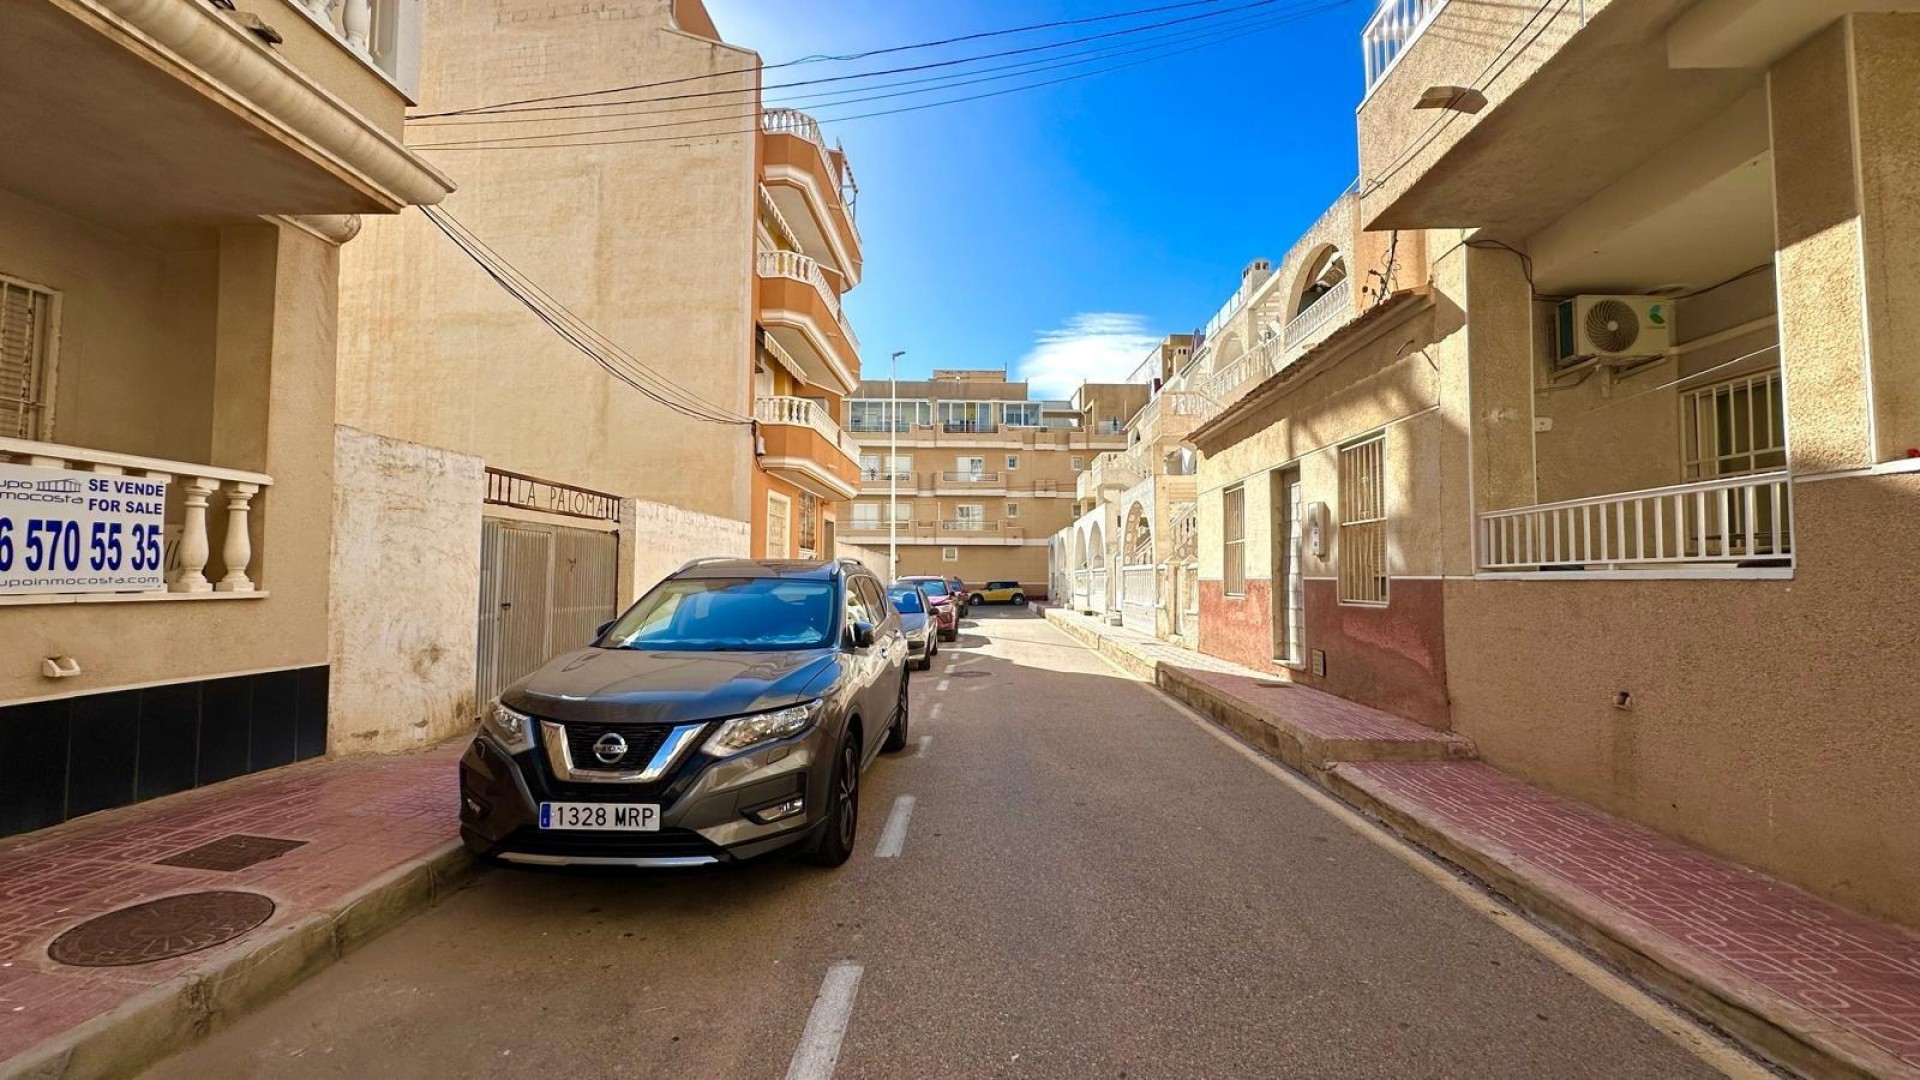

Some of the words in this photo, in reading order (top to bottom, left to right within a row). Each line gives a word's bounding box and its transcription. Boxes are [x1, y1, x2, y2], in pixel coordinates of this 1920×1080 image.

[89, 479, 108, 492] SE
[114, 481, 164, 497] VENDE
[518, 479, 536, 507] LA
[551, 486, 603, 516] PALOMA
[89, 499, 120, 512] FOR
[126, 502, 162, 515] SALE
[0, 517, 13, 572] 6
[25, 519, 80, 572] 570
[90, 522, 122, 571] 55
[131, 523, 160, 571] 35
[557, 806, 606, 826] 1328
[615, 807, 654, 827] MRP
